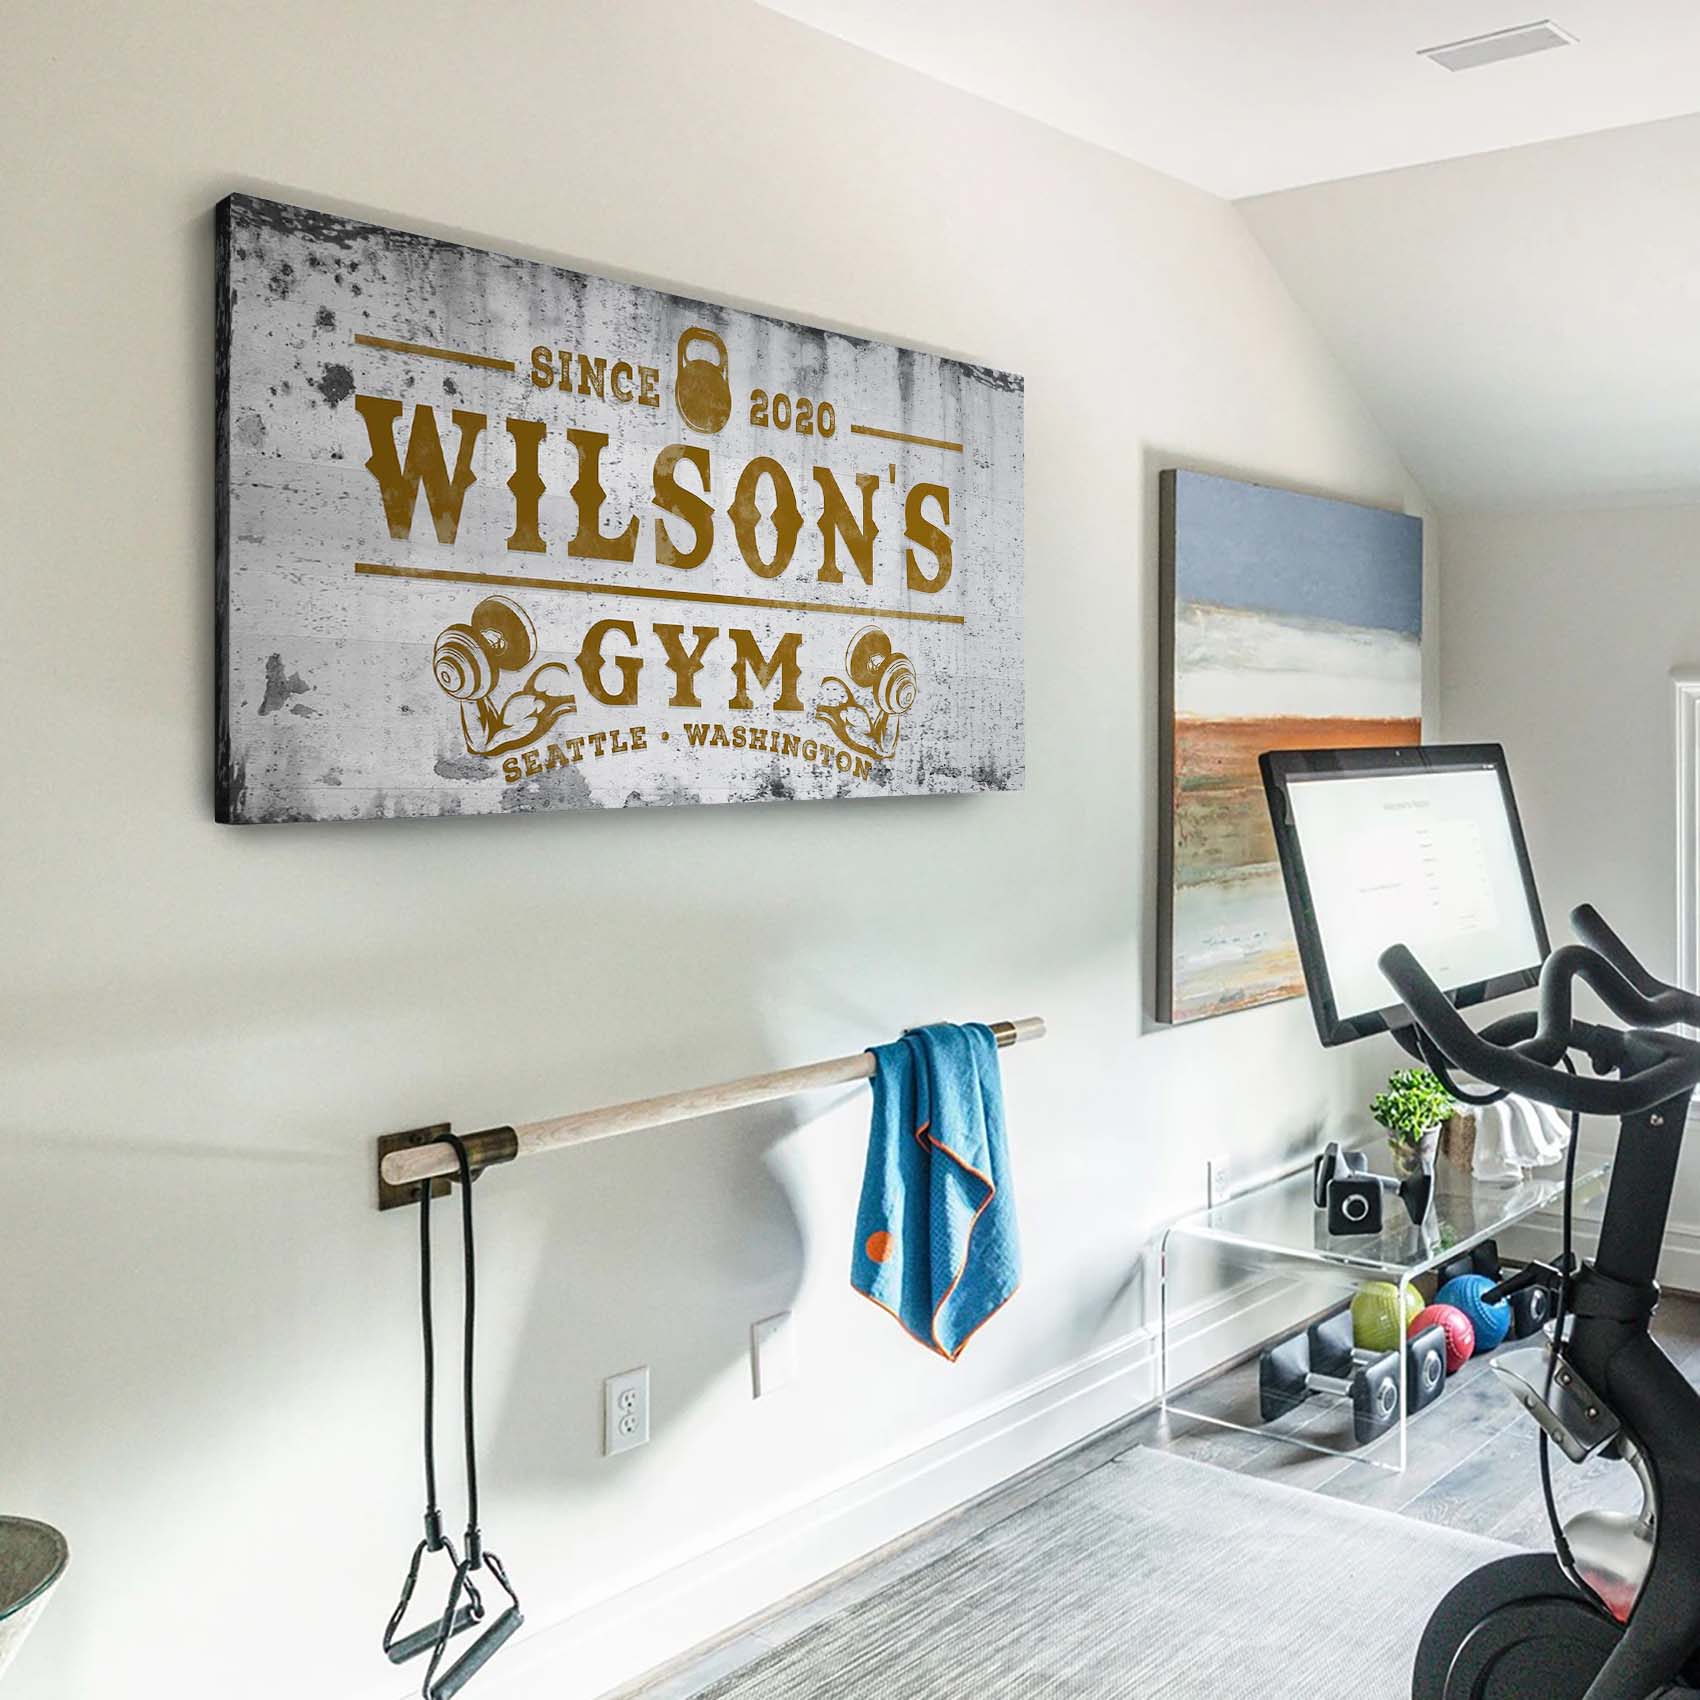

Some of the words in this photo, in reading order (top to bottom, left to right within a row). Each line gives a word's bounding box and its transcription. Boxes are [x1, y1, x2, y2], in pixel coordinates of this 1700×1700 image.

[531, 346, 660, 408] SINCE
[750, 388, 836, 438] 2020
[355, 394, 953, 594] WILSON'S
[576, 619, 804, 711] GYM
[502, 726, 647, 783] SEATTLE
[683, 723, 872, 780] WASHINGTON
